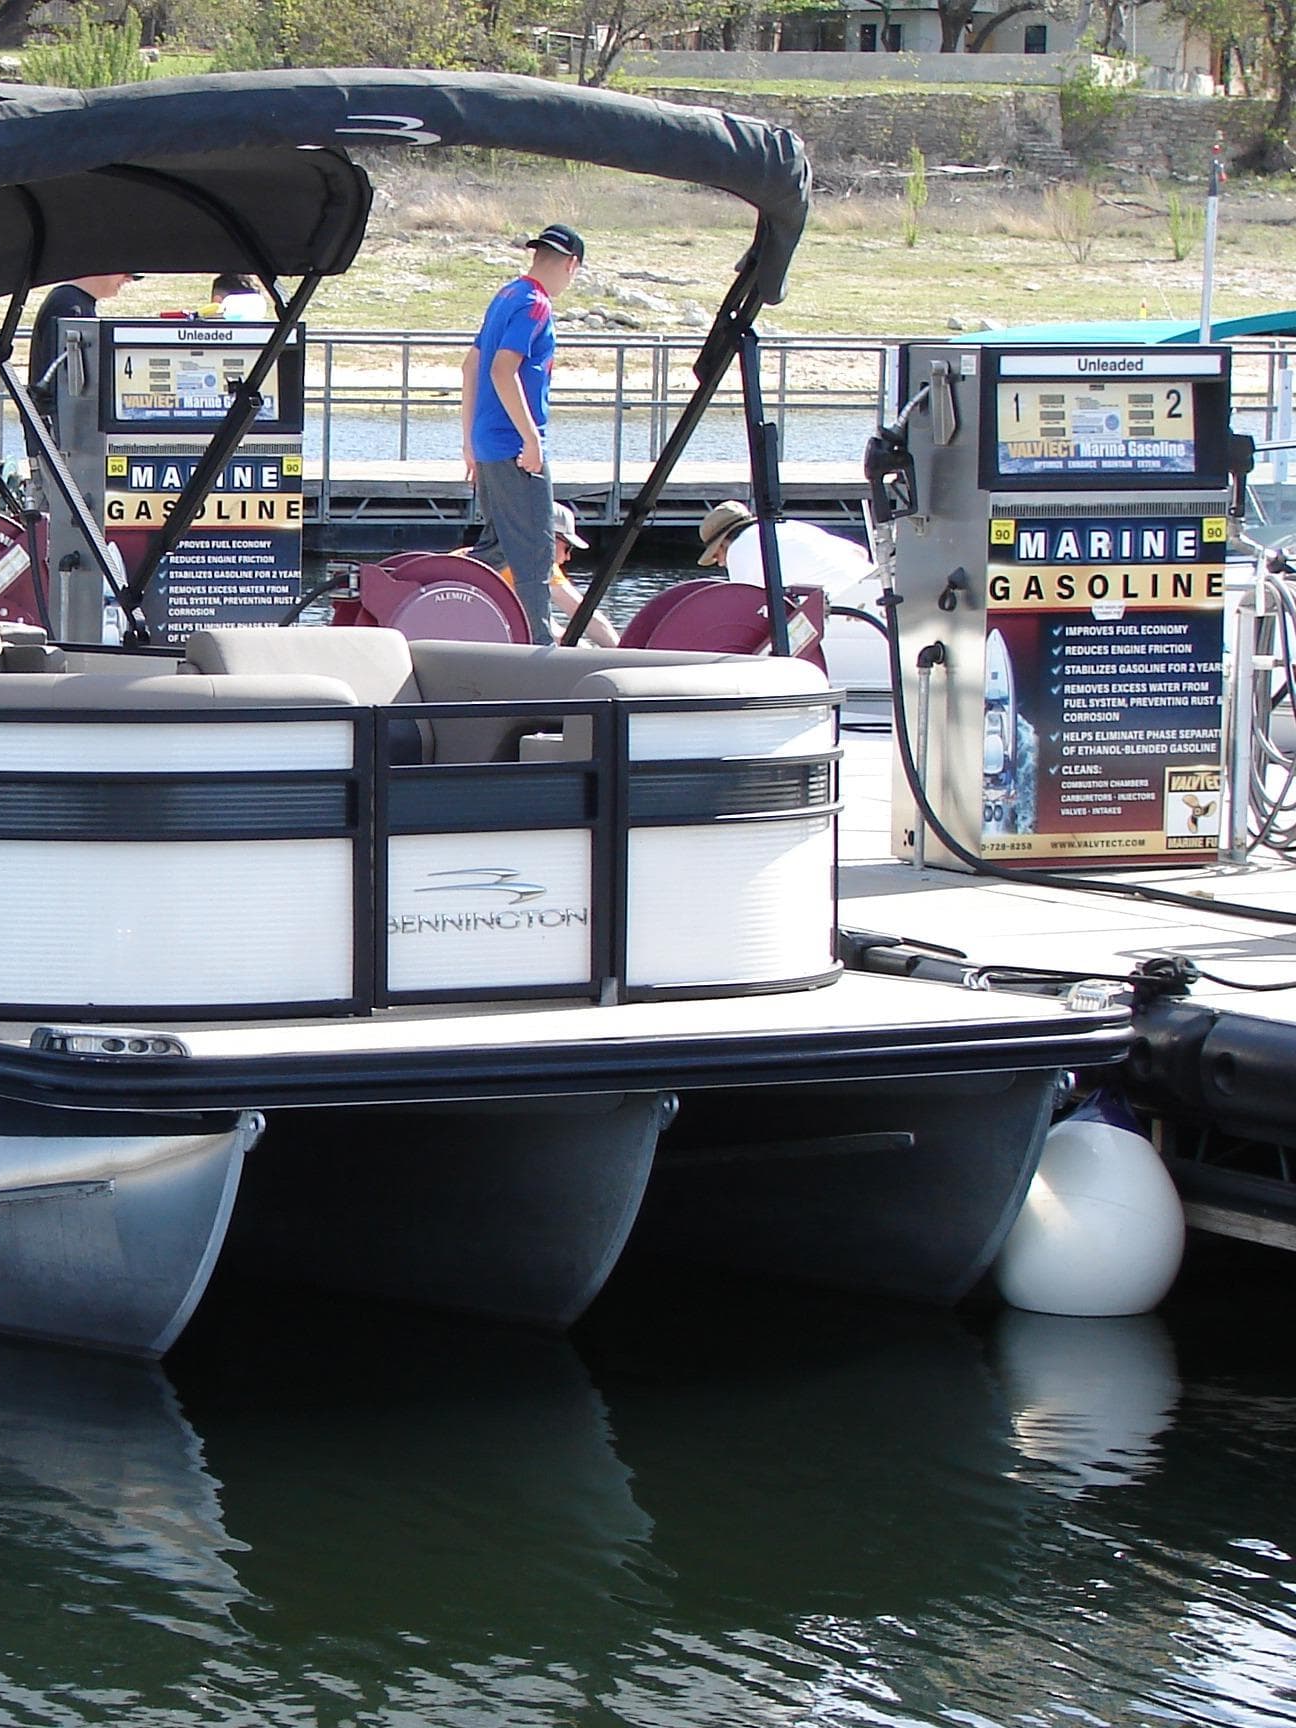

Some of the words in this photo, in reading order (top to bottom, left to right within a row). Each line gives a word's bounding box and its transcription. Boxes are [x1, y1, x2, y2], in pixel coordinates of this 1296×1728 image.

[178, 329, 233, 341] Unleaded
[124, 356, 133, 380] 4
[1078, 358, 1144, 372] Unleaded
[1014, 393, 1020, 422] 1
[1166, 389, 1182, 419] 2
[1080, 441, 1126, 457] Marine
[1128, 441, 1186, 457] Gasoline
[111, 464, 124, 473] 90
[286, 464, 299, 472] 90
[995, 530, 1010, 540] 90
[1207, 528, 1222, 538] 90
[212, 540, 231, 549] FUEL
[232, 540, 272, 549] ECONOMY
[1020, 530, 1196, 559] MARINE
[169, 556, 206, 564] REDUCES
[208, 556, 236, 564] ENGINE
[238, 556, 275, 564] FRICTION
[169, 570, 212, 578] STABILIZES
[214, 570, 253, 578] GASOLINE
[255, 570, 270, 578] FOR
[272, 570, 278, 578] 2
[168, 586, 206, 594] REMOVES
[208, 586, 238, 594] EXCESS
[239, 586, 265, 594] WATER
[266, 585, 288, 593] FROM
[990, 573, 1224, 600] GASOLINE
[168, 596, 188, 605] FUEL
[224, 596, 272, 605] PREVENTING
[274, 596, 294, 604] RUST
[168, 608, 216, 616] CORROSION
[168, 623, 194, 631] HELPS
[1066, 626, 1114, 636] IMPROVES
[1116, 625, 1140, 636] FUEL
[1141, 624, 1188, 635] ECONOMY
[168, 634, 178, 642] OF
[1065, 646, 1109, 656] REDUCES
[1111, 645, 1146, 654] ENGINE
[1148, 644, 1192, 654] FRICTION
[1064, 664, 1117, 675] STABILIZES
[1118, 664, 1166, 674] GASOLINE
[1168, 663, 1186, 672] FOR
[1188, 662, 1195, 672] 2
[1064, 684, 1110, 694] REMOVES
[1112, 683, 1147, 693] EXCESS
[1149, 682, 1180, 692] WATER
[1182, 682, 1209, 692] FROM
[1064, 698, 1088, 708] FUEL
[1089, 698, 1128, 708] SYSTEM,
[1130, 696, 1189, 706] PREVENTING
[1190, 696, 1214, 705] RUST
[1064, 712, 1120, 722] CORROSION
[1063, 732, 1093, 742] HELPS
[1095, 730, 1144, 741] ELIMINATE
[1146, 730, 1177, 740] PHASE
[1062, 746, 1076, 756] OF
[1078, 744, 1168, 755] ETHANOL-BLENDED
[1170, 743, 1216, 753] GASOLINE
[1062, 766, 1102, 775] CLEANS:
[1061, 780, 1108, 789] COMBUSTION
[1110, 779, 1149, 788] CHAMBERS
[1060, 794, 1112, 802] CARBURETORS
[1118, 792, 1156, 801] INJECTORS
[1060, 808, 1086, 816] VALVES
[1092, 807, 1122, 815] INTAKES
[1050, 838, 1146, 849] WWW.VALVTECT.COM
[1168, 838, 1204, 848] MARINE
